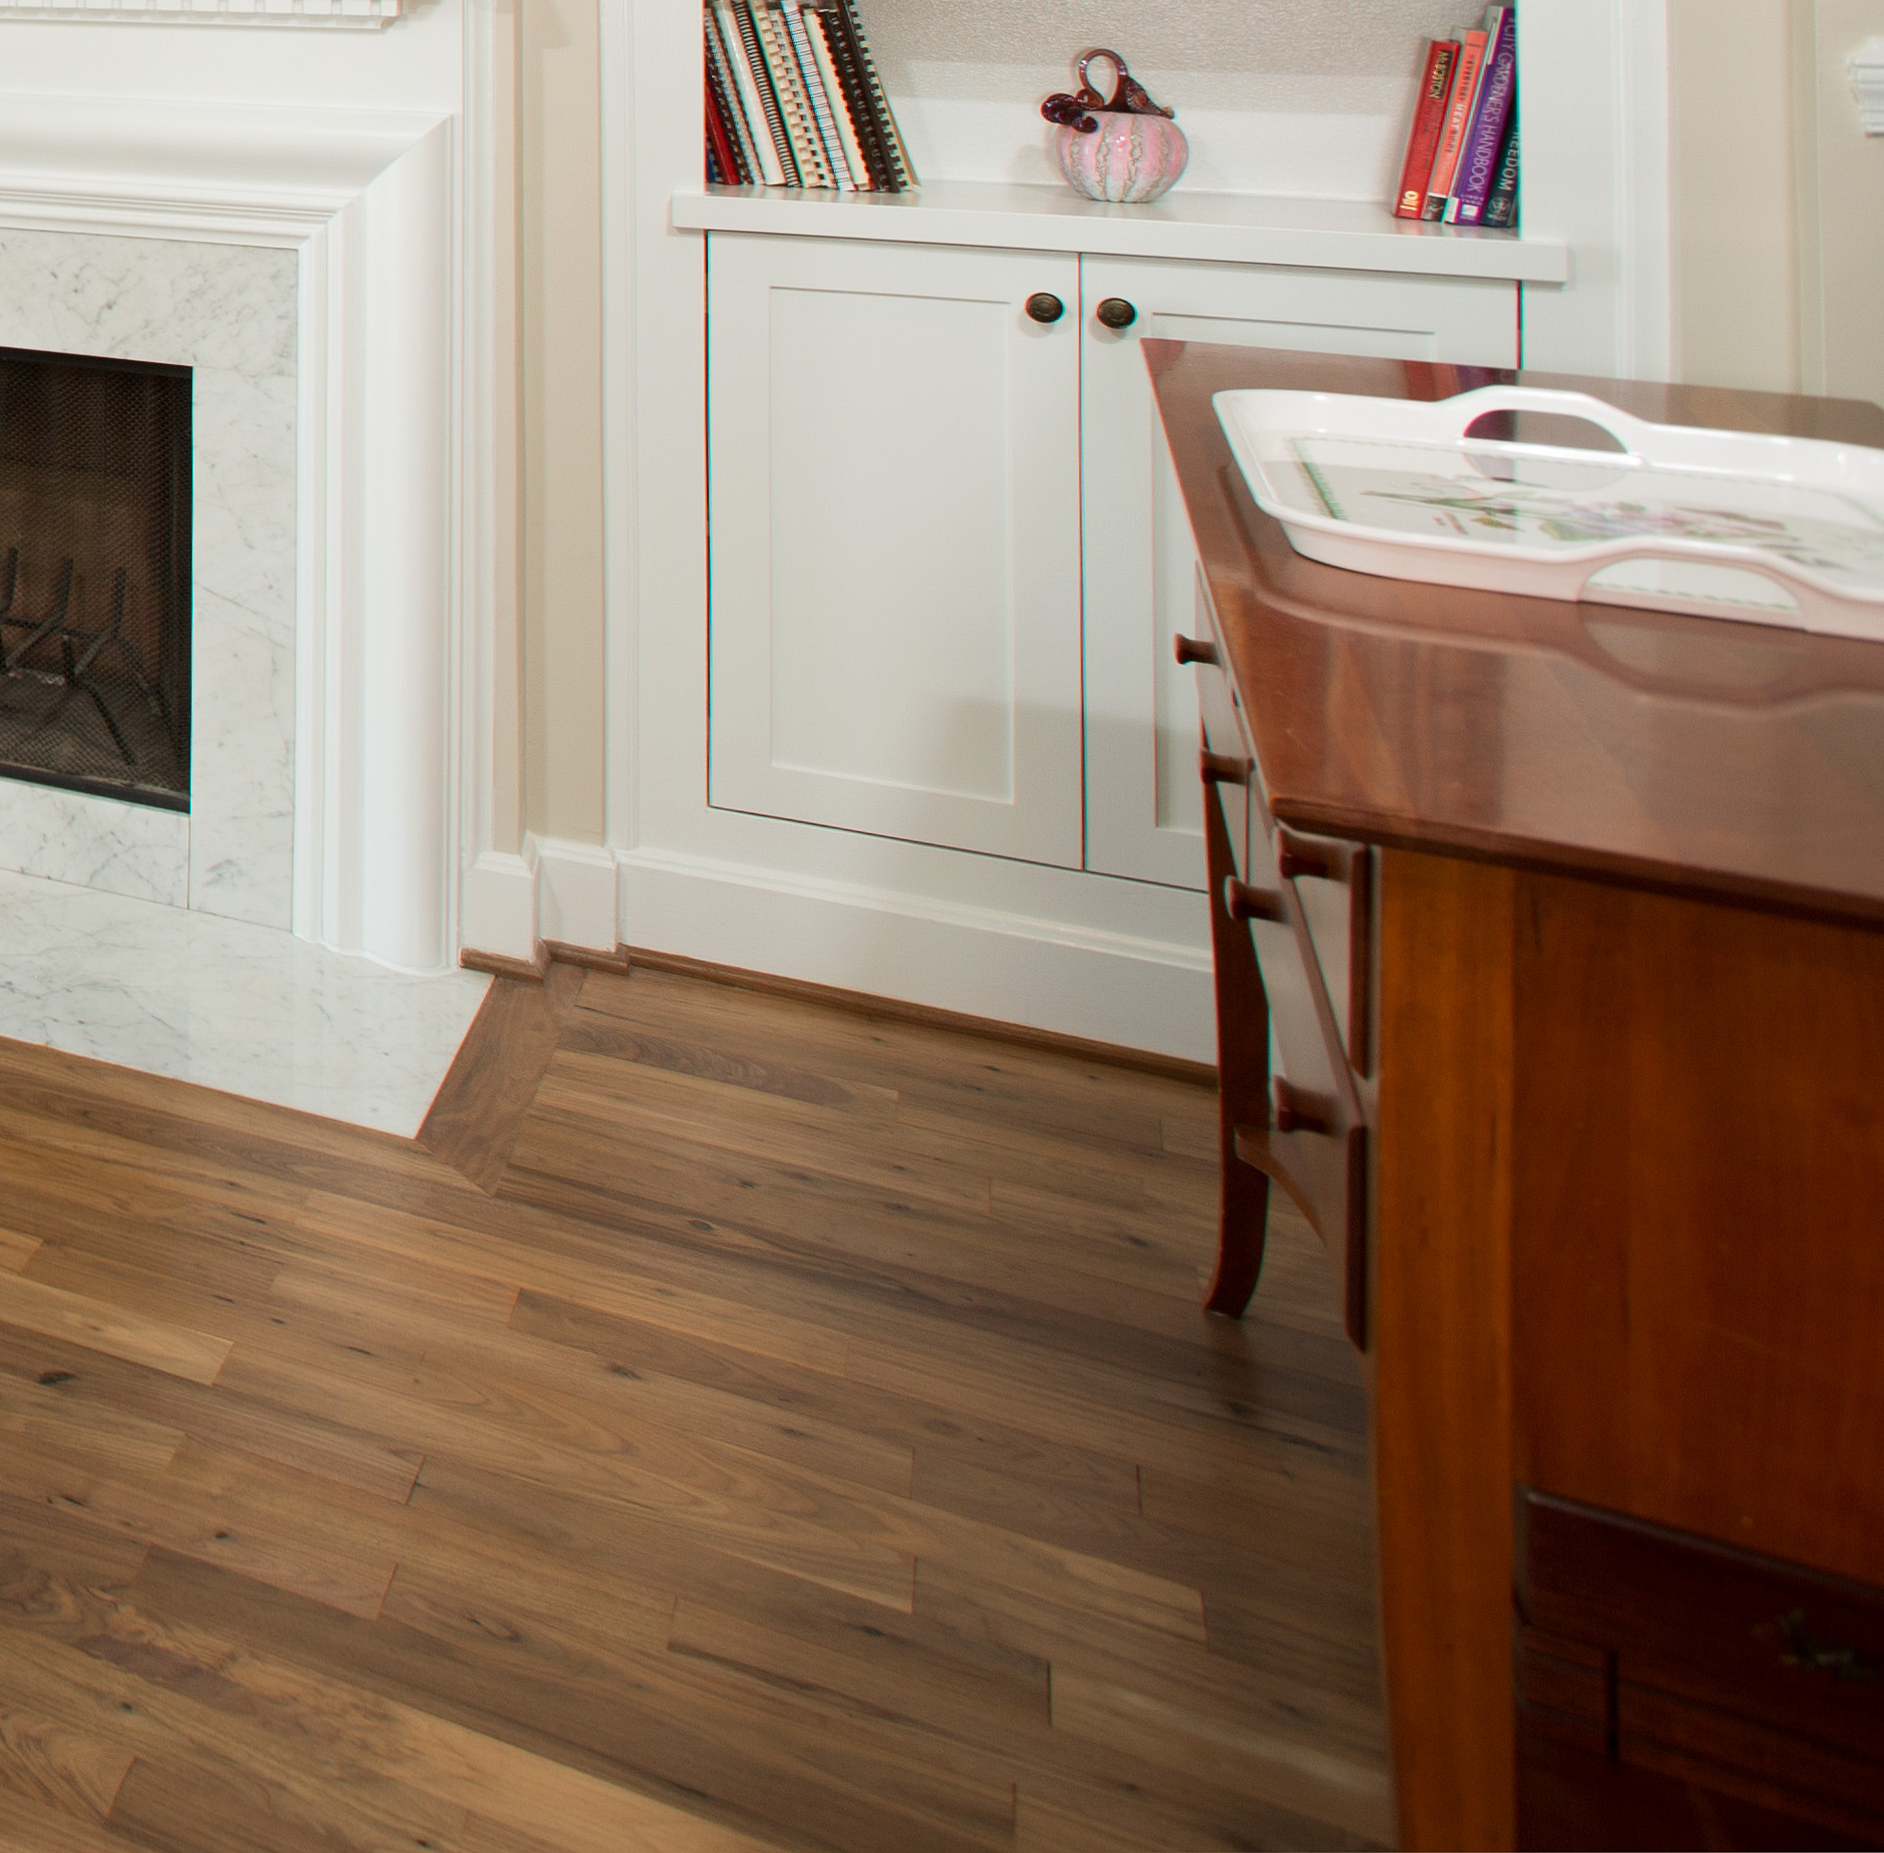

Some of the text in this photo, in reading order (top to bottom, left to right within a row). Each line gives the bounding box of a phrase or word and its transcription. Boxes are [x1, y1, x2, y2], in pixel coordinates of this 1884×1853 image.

[1502, 23, 1515, 51] CITY
[1482, 52, 1513, 123] GARDENER'S
[1450, 104, 1465, 129] MEAT
[1467, 125, 1497, 192] HANDBOOK
